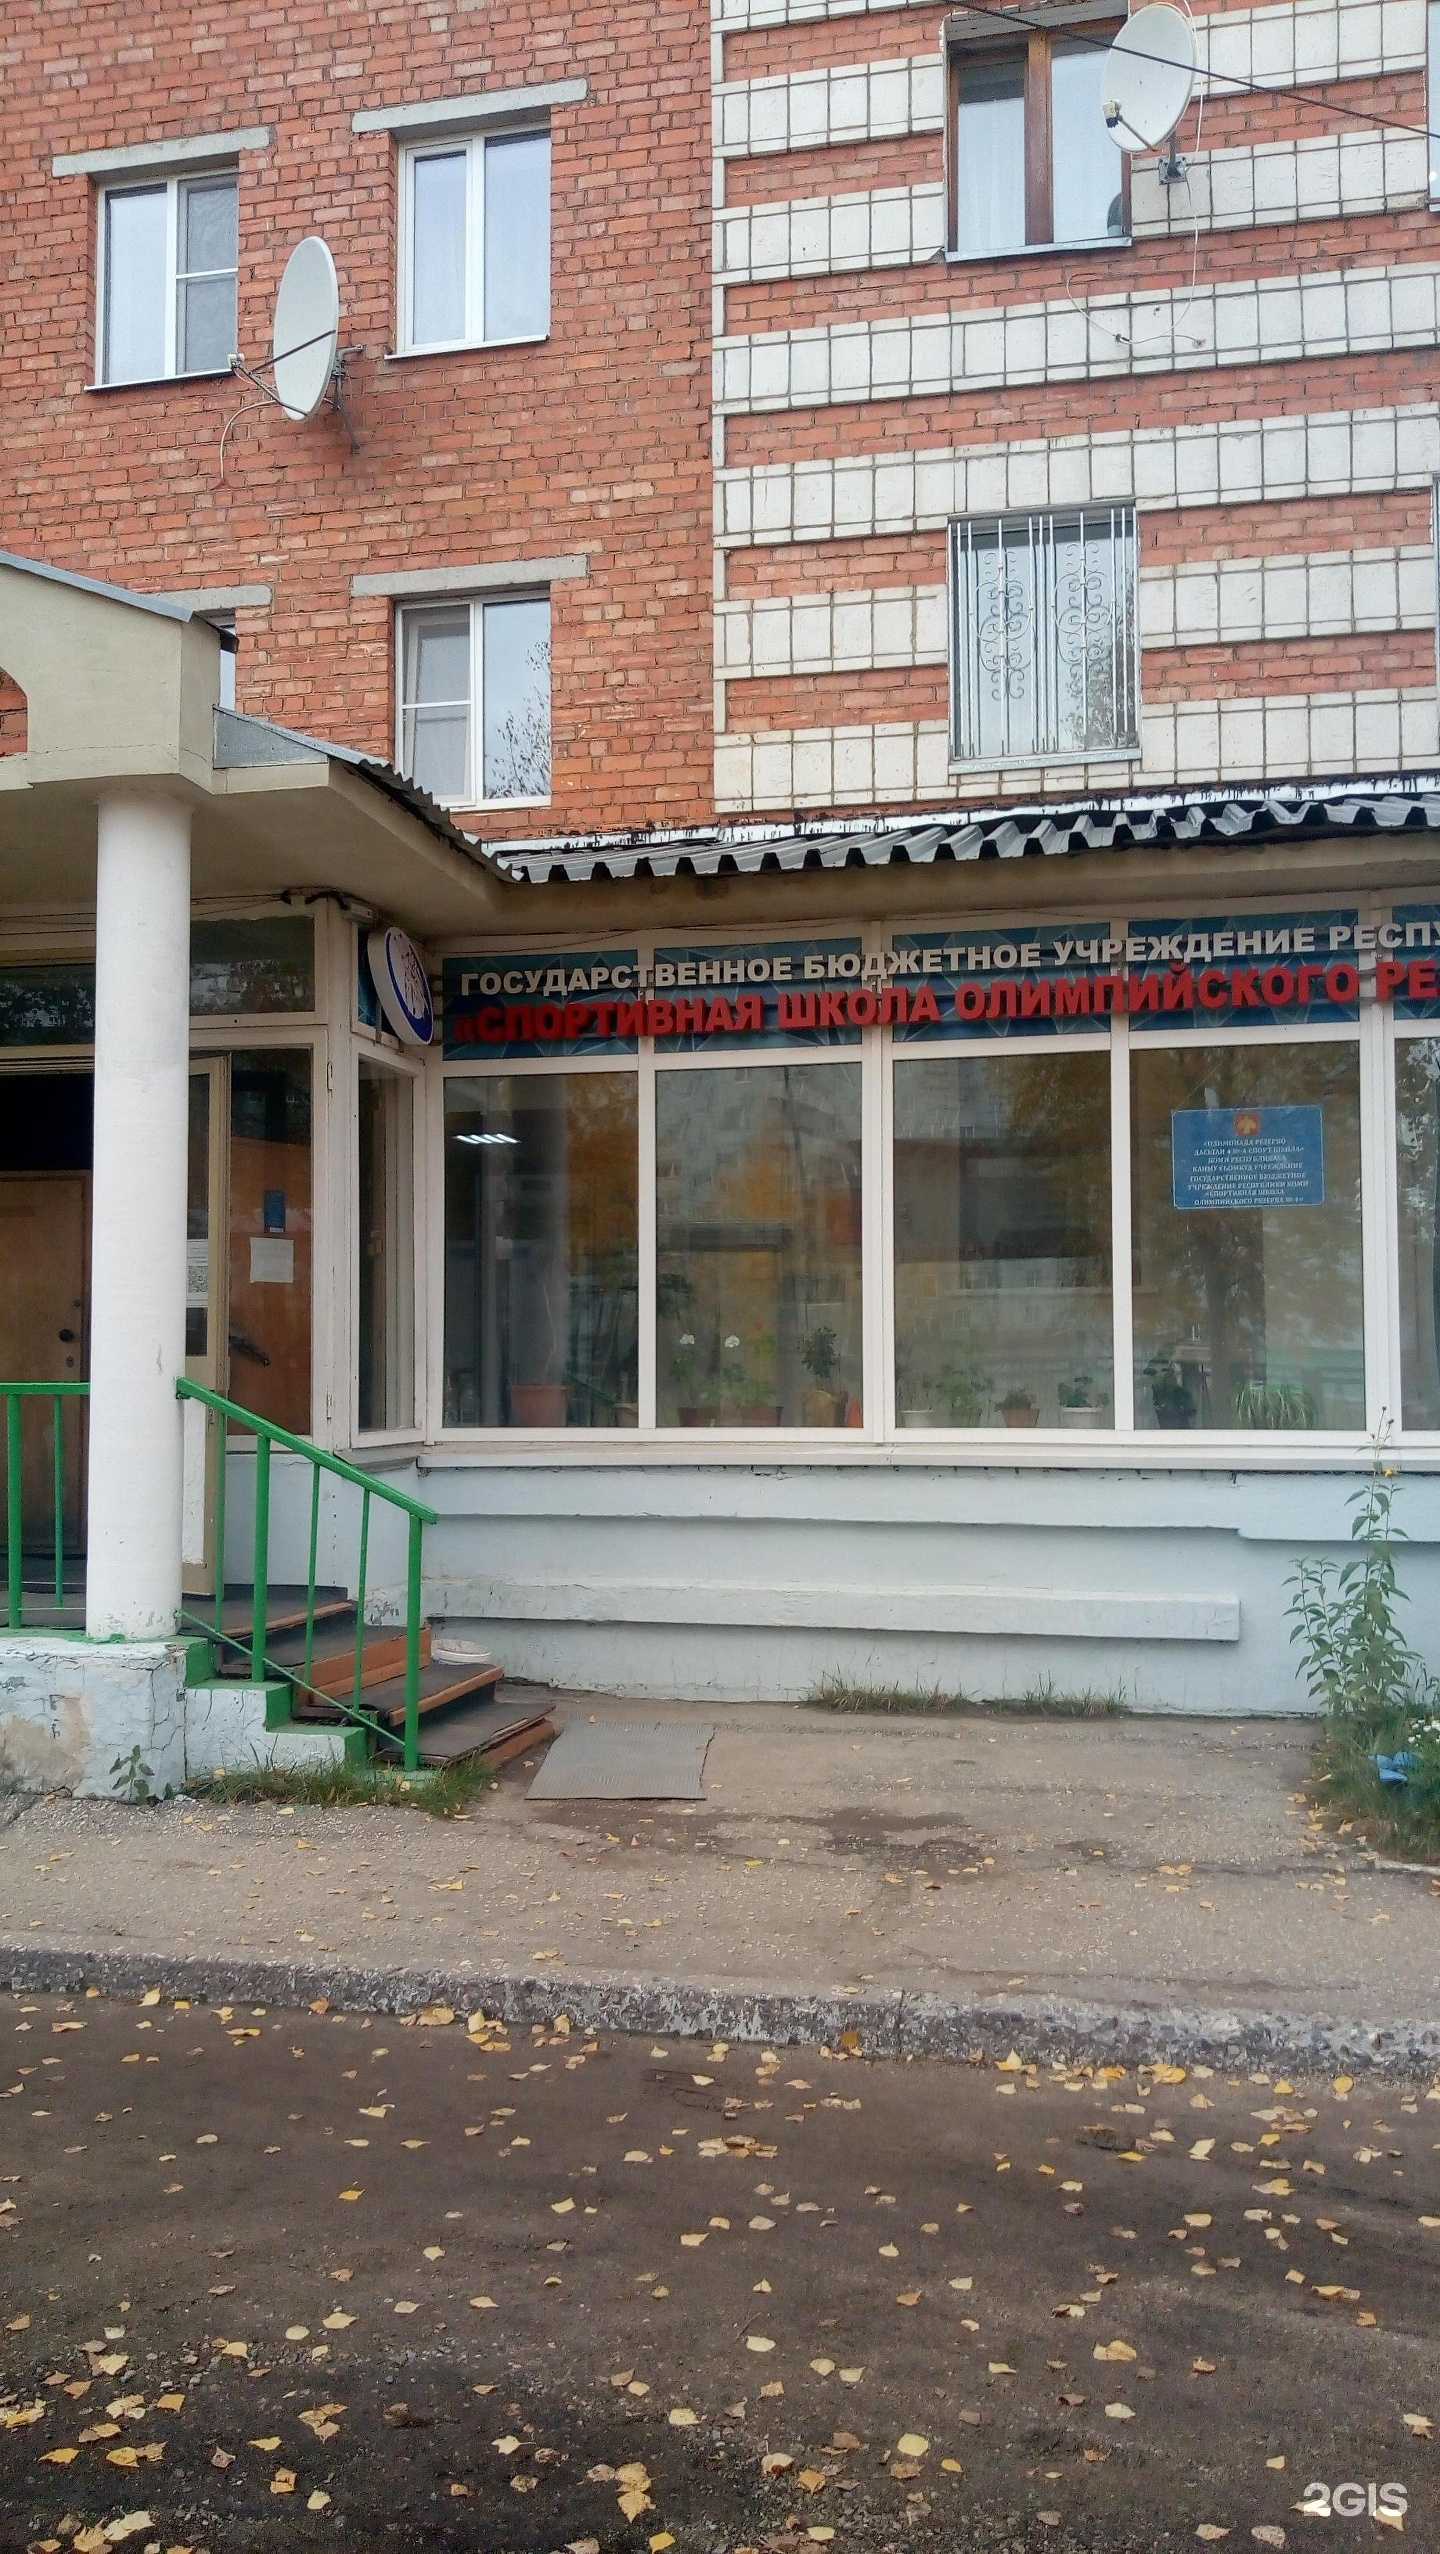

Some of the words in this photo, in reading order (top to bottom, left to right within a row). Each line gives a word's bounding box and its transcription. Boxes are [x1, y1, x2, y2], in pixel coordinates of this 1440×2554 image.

[461, 956, 794, 997] ГОСУДАРСТВЕННОЕ
[803, 943, 1041, 981] БЮДЖЕТНОЕ
[1052, 927, 1316, 966] УЧРЕЖДЕНИЕ
[777, 985, 941, 1029] ШКОЛА
[955, 961, 1360, 1021] ОЛИМПИЙСКОГО
[1376, 960, 1440, 1003] РЕ
